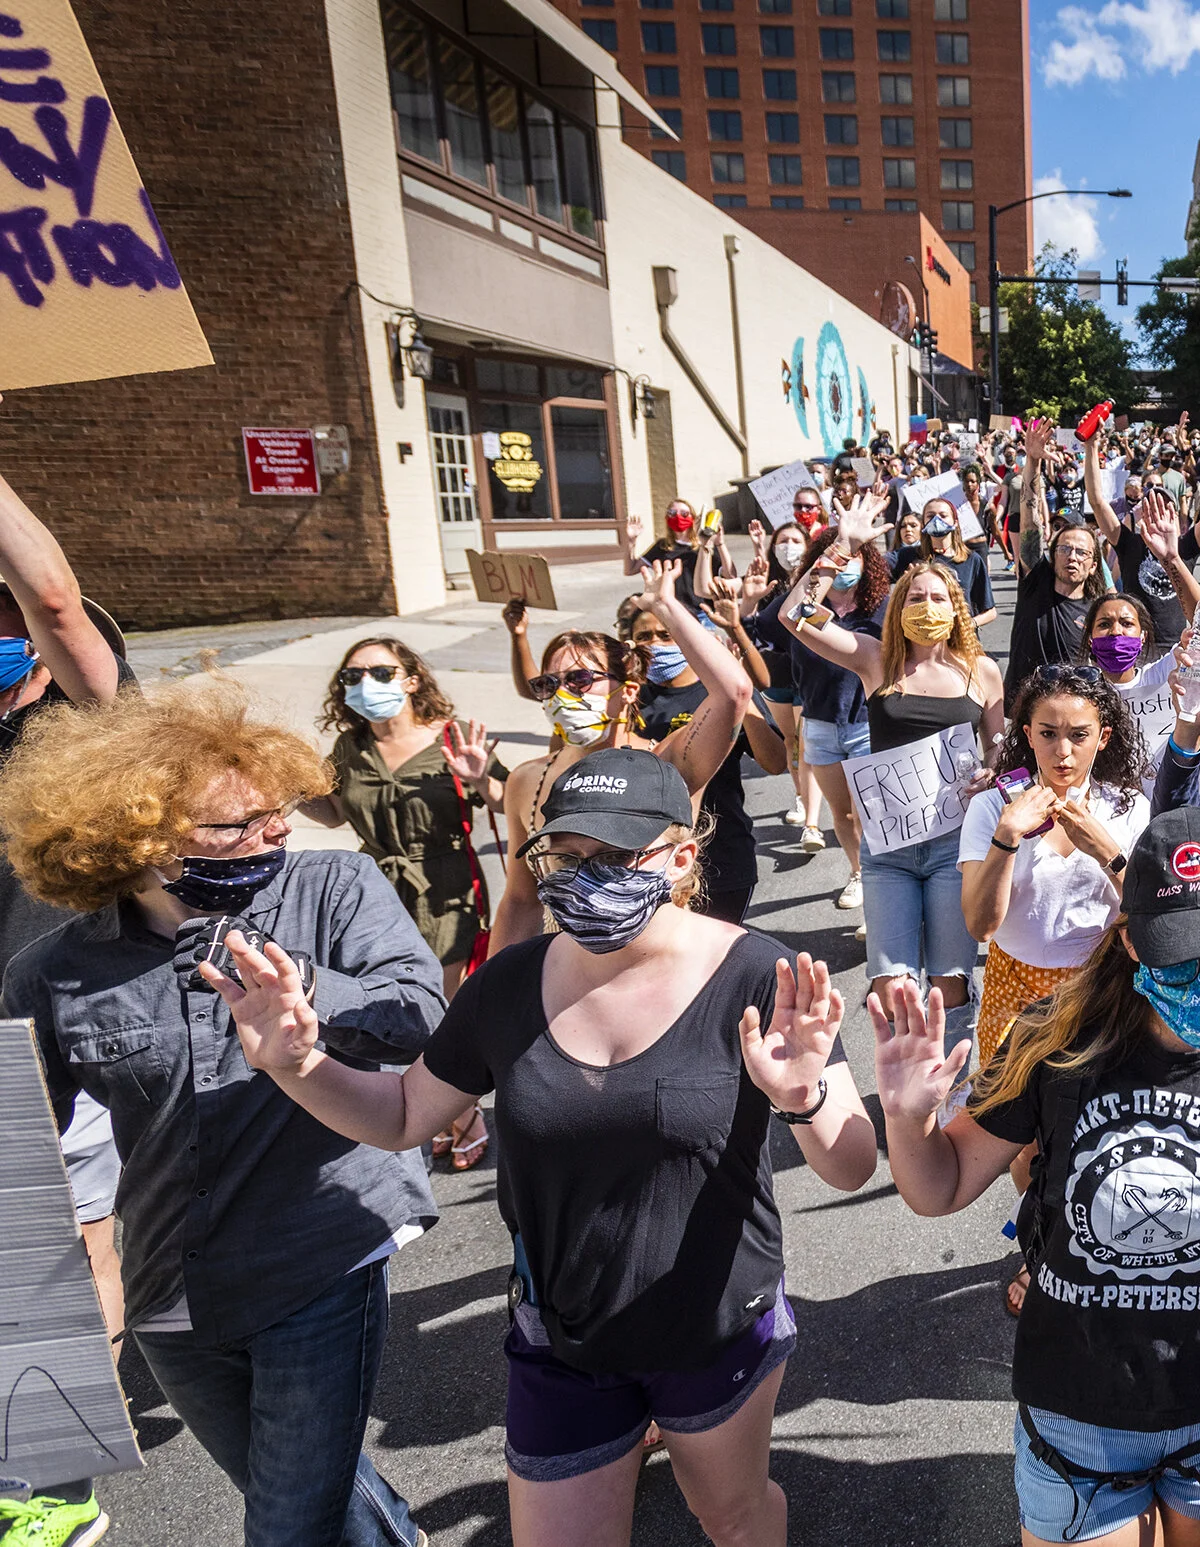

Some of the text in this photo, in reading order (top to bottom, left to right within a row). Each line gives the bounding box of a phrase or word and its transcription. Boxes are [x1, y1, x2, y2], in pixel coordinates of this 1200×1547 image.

[245, 430, 310, 439] Unauthorized
[258, 439, 300, 448] Vehicles
[264, 447, 298, 456] Towed
[262, 465, 305, 474] Expense
[481, 560, 542, 603] BLM
[562, 774, 628, 792] BORING
[852, 751, 937, 820] FREE
[578, 785, 626, 795] COMPANY
[1156, 884, 1183, 898] CLASS
[1074, 1203, 1096, 1245] CITY
[1092, 1247, 1117, 1262] OF
[1120, 1251, 1178, 1267] WHITE
